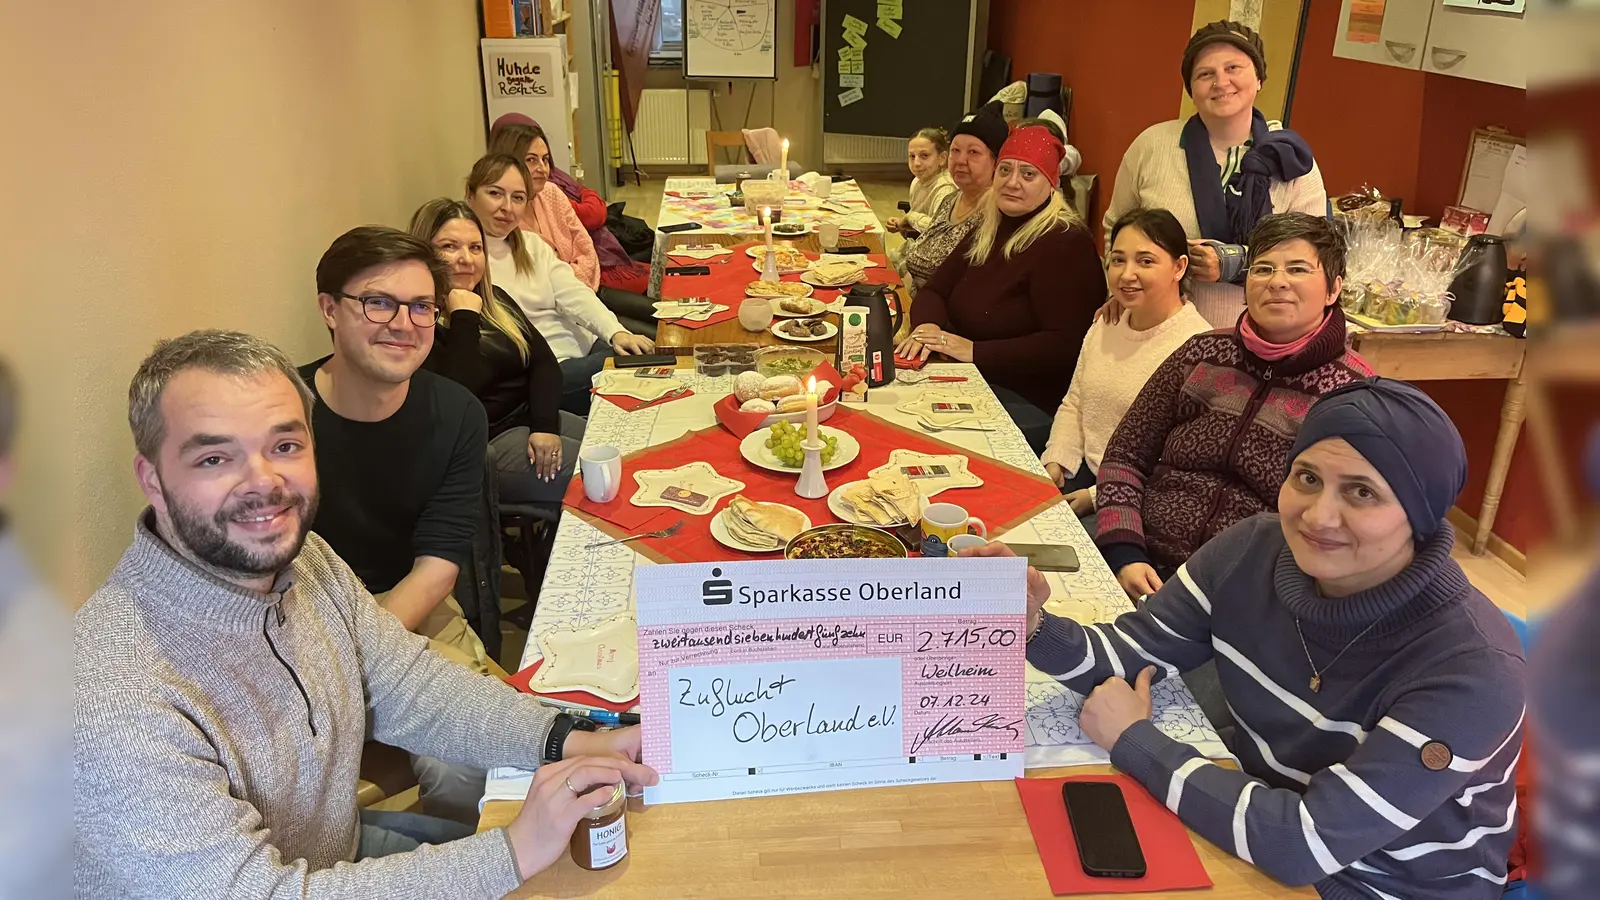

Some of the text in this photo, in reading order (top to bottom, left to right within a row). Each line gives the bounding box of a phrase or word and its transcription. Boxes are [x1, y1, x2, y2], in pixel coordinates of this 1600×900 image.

[497, 57, 541, 77] Hunde
[498, 81, 548, 95] Rechts
[738, 581, 961, 608] Sparkasse Oberland
[643, 623, 754, 636] Zahlen Sie gegen diesen Scheck
[878, 633, 903, 643] EUR
[917, 626, 1017, 653] 2.715,00
[681, 648, 719, 662] Verrechnung
[921, 663, 998, 679] Weilheim
[678, 674, 796, 717] Zuflucht
[732, 702, 865, 743] Oberland
[596, 822, 622, 840] HONIG
